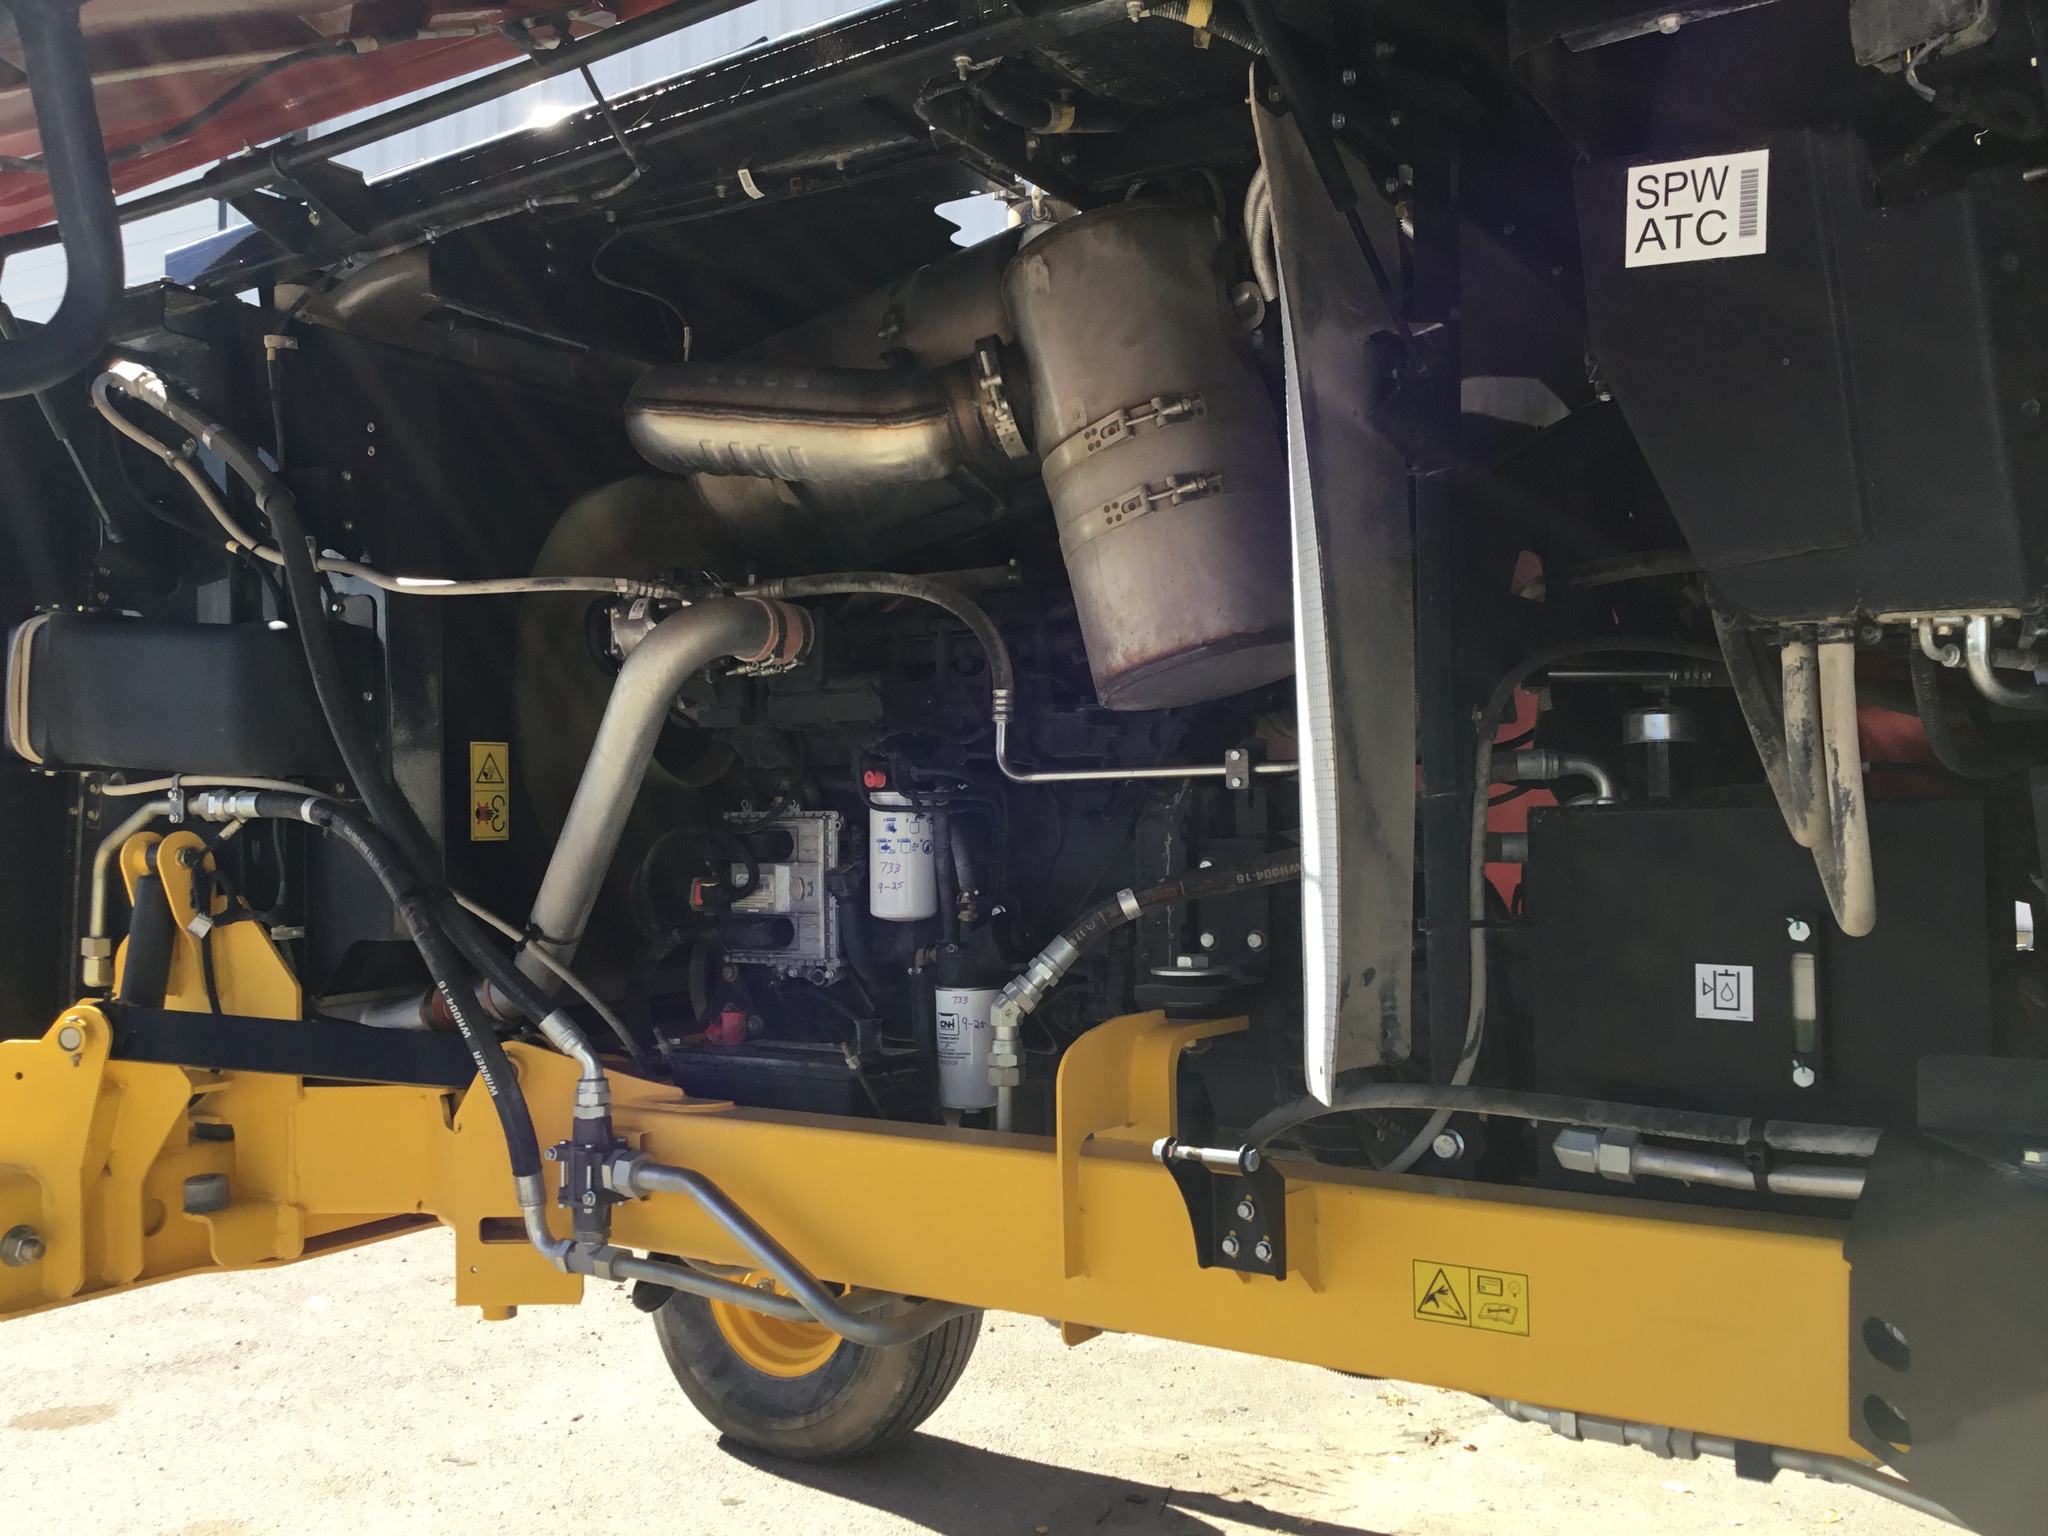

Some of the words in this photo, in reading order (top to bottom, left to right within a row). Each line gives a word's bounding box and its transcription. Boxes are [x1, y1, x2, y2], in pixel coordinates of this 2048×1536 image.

[1635, 165, 1730, 210] SPW
[1634, 209, 1728, 254] ATC
[880, 861, 902, 875] 733
[952, 995, 969, 1005] 733
[472, 1050, 499, 1097] WINNER
